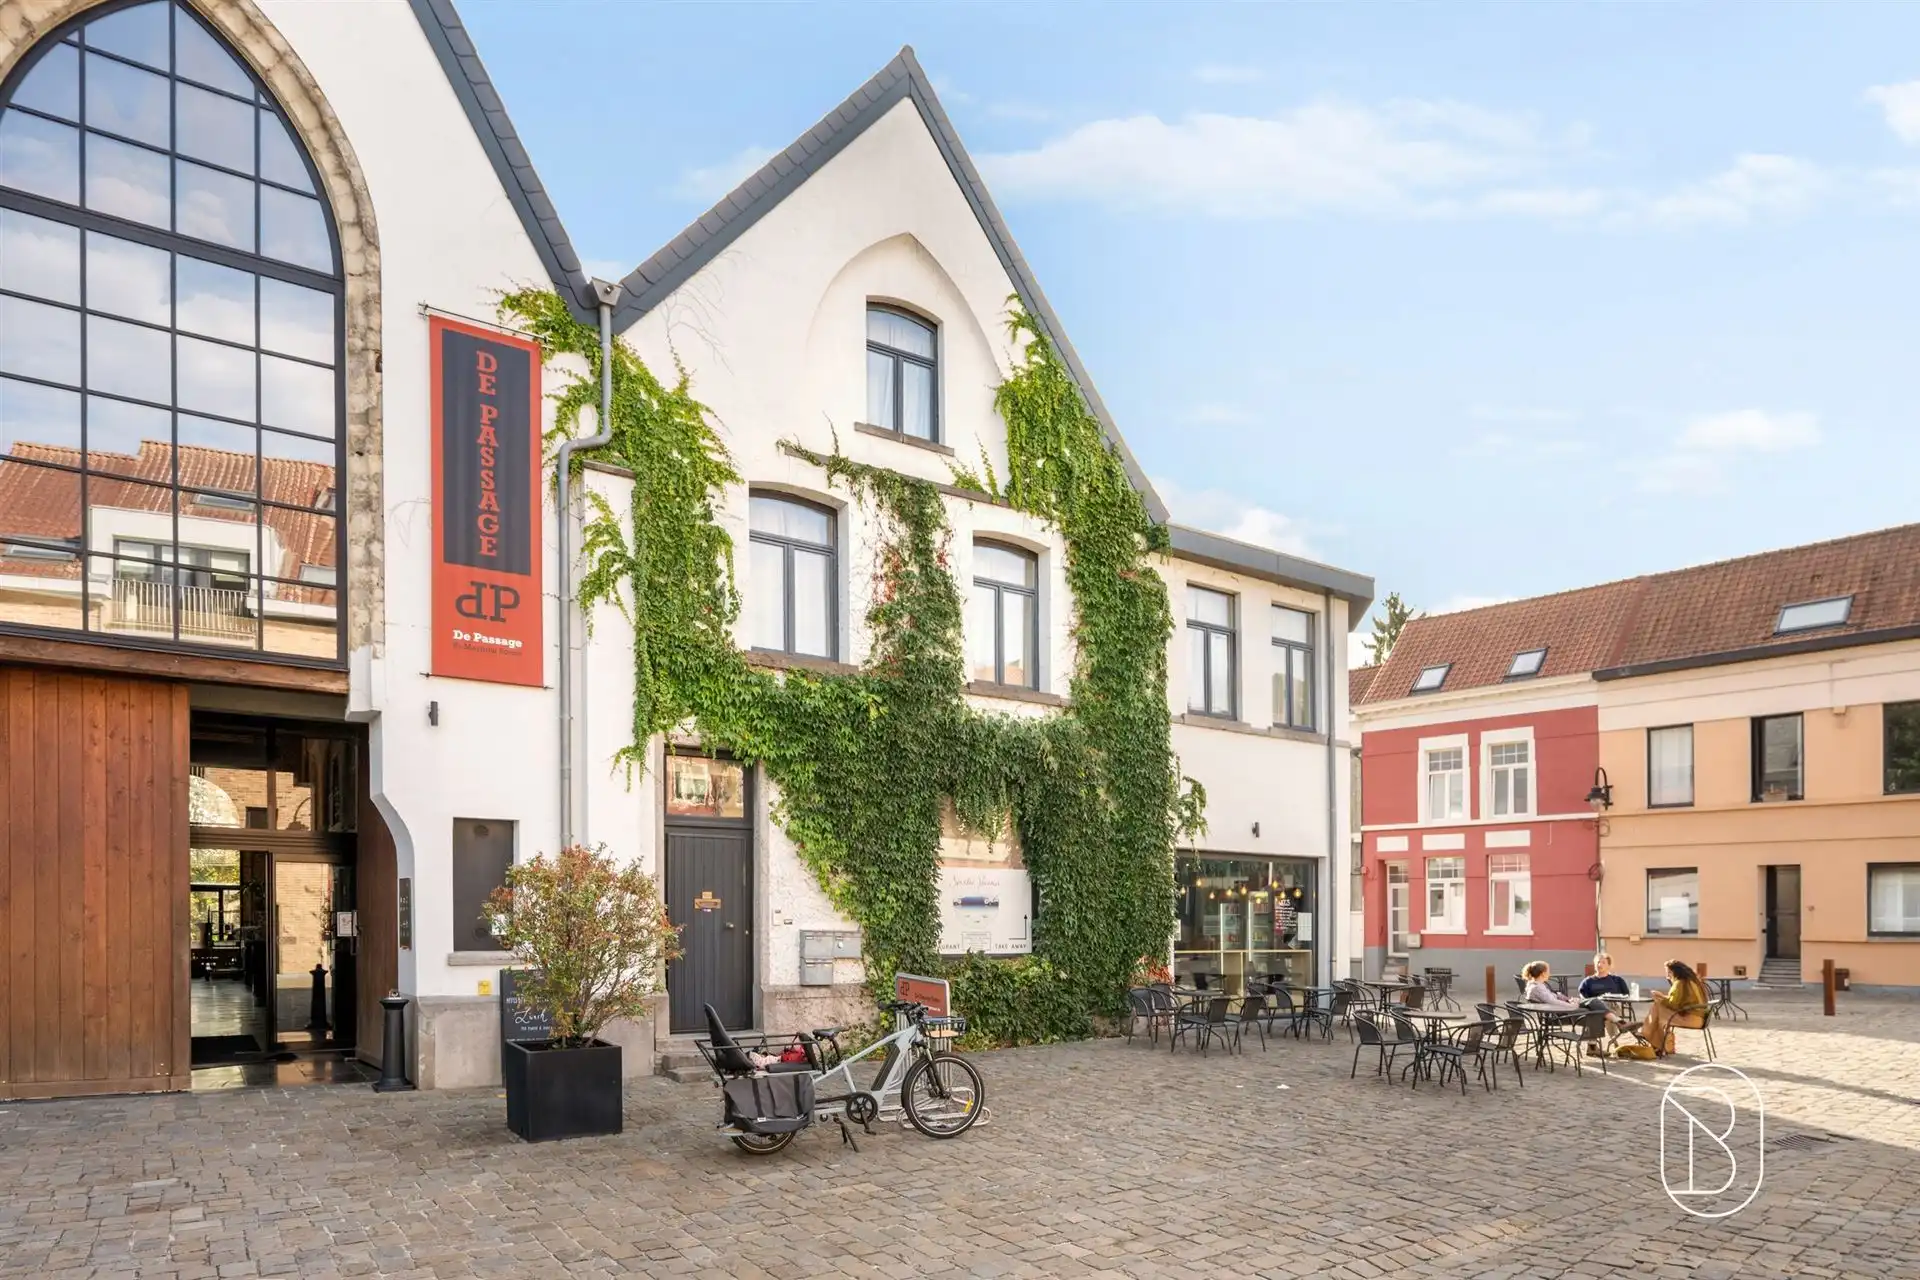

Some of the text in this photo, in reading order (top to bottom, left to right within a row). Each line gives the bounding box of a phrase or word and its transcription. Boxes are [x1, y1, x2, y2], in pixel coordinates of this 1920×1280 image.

[476, 350, 501, 557] DE PASSAGE
[452, 629, 523, 649] De Passage
